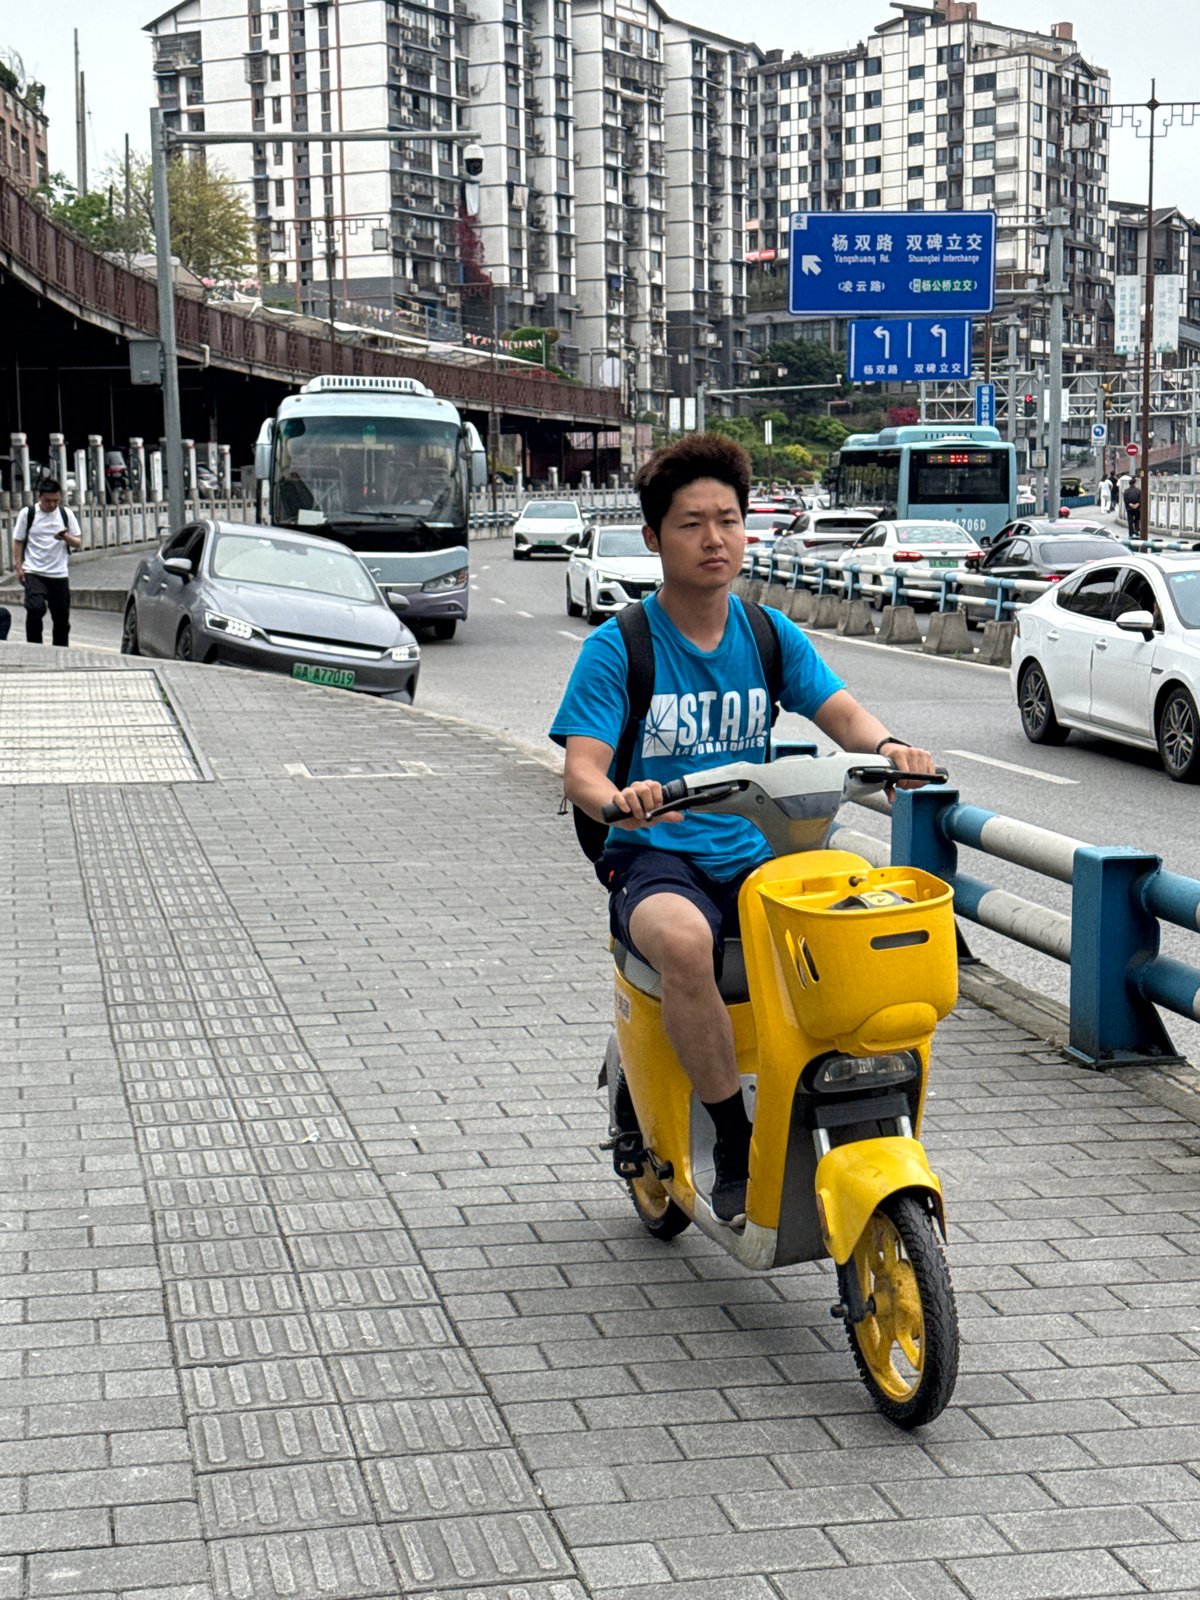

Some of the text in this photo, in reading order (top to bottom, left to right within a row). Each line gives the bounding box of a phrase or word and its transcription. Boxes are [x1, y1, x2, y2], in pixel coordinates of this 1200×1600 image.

[831, 233, 983, 252] 杨双路 双碑立交
[834, 254, 980, 265] Yangshuang Rd. Shuangbei Interchange
[863, 362, 962, 375] 杨双路 双碑立交
